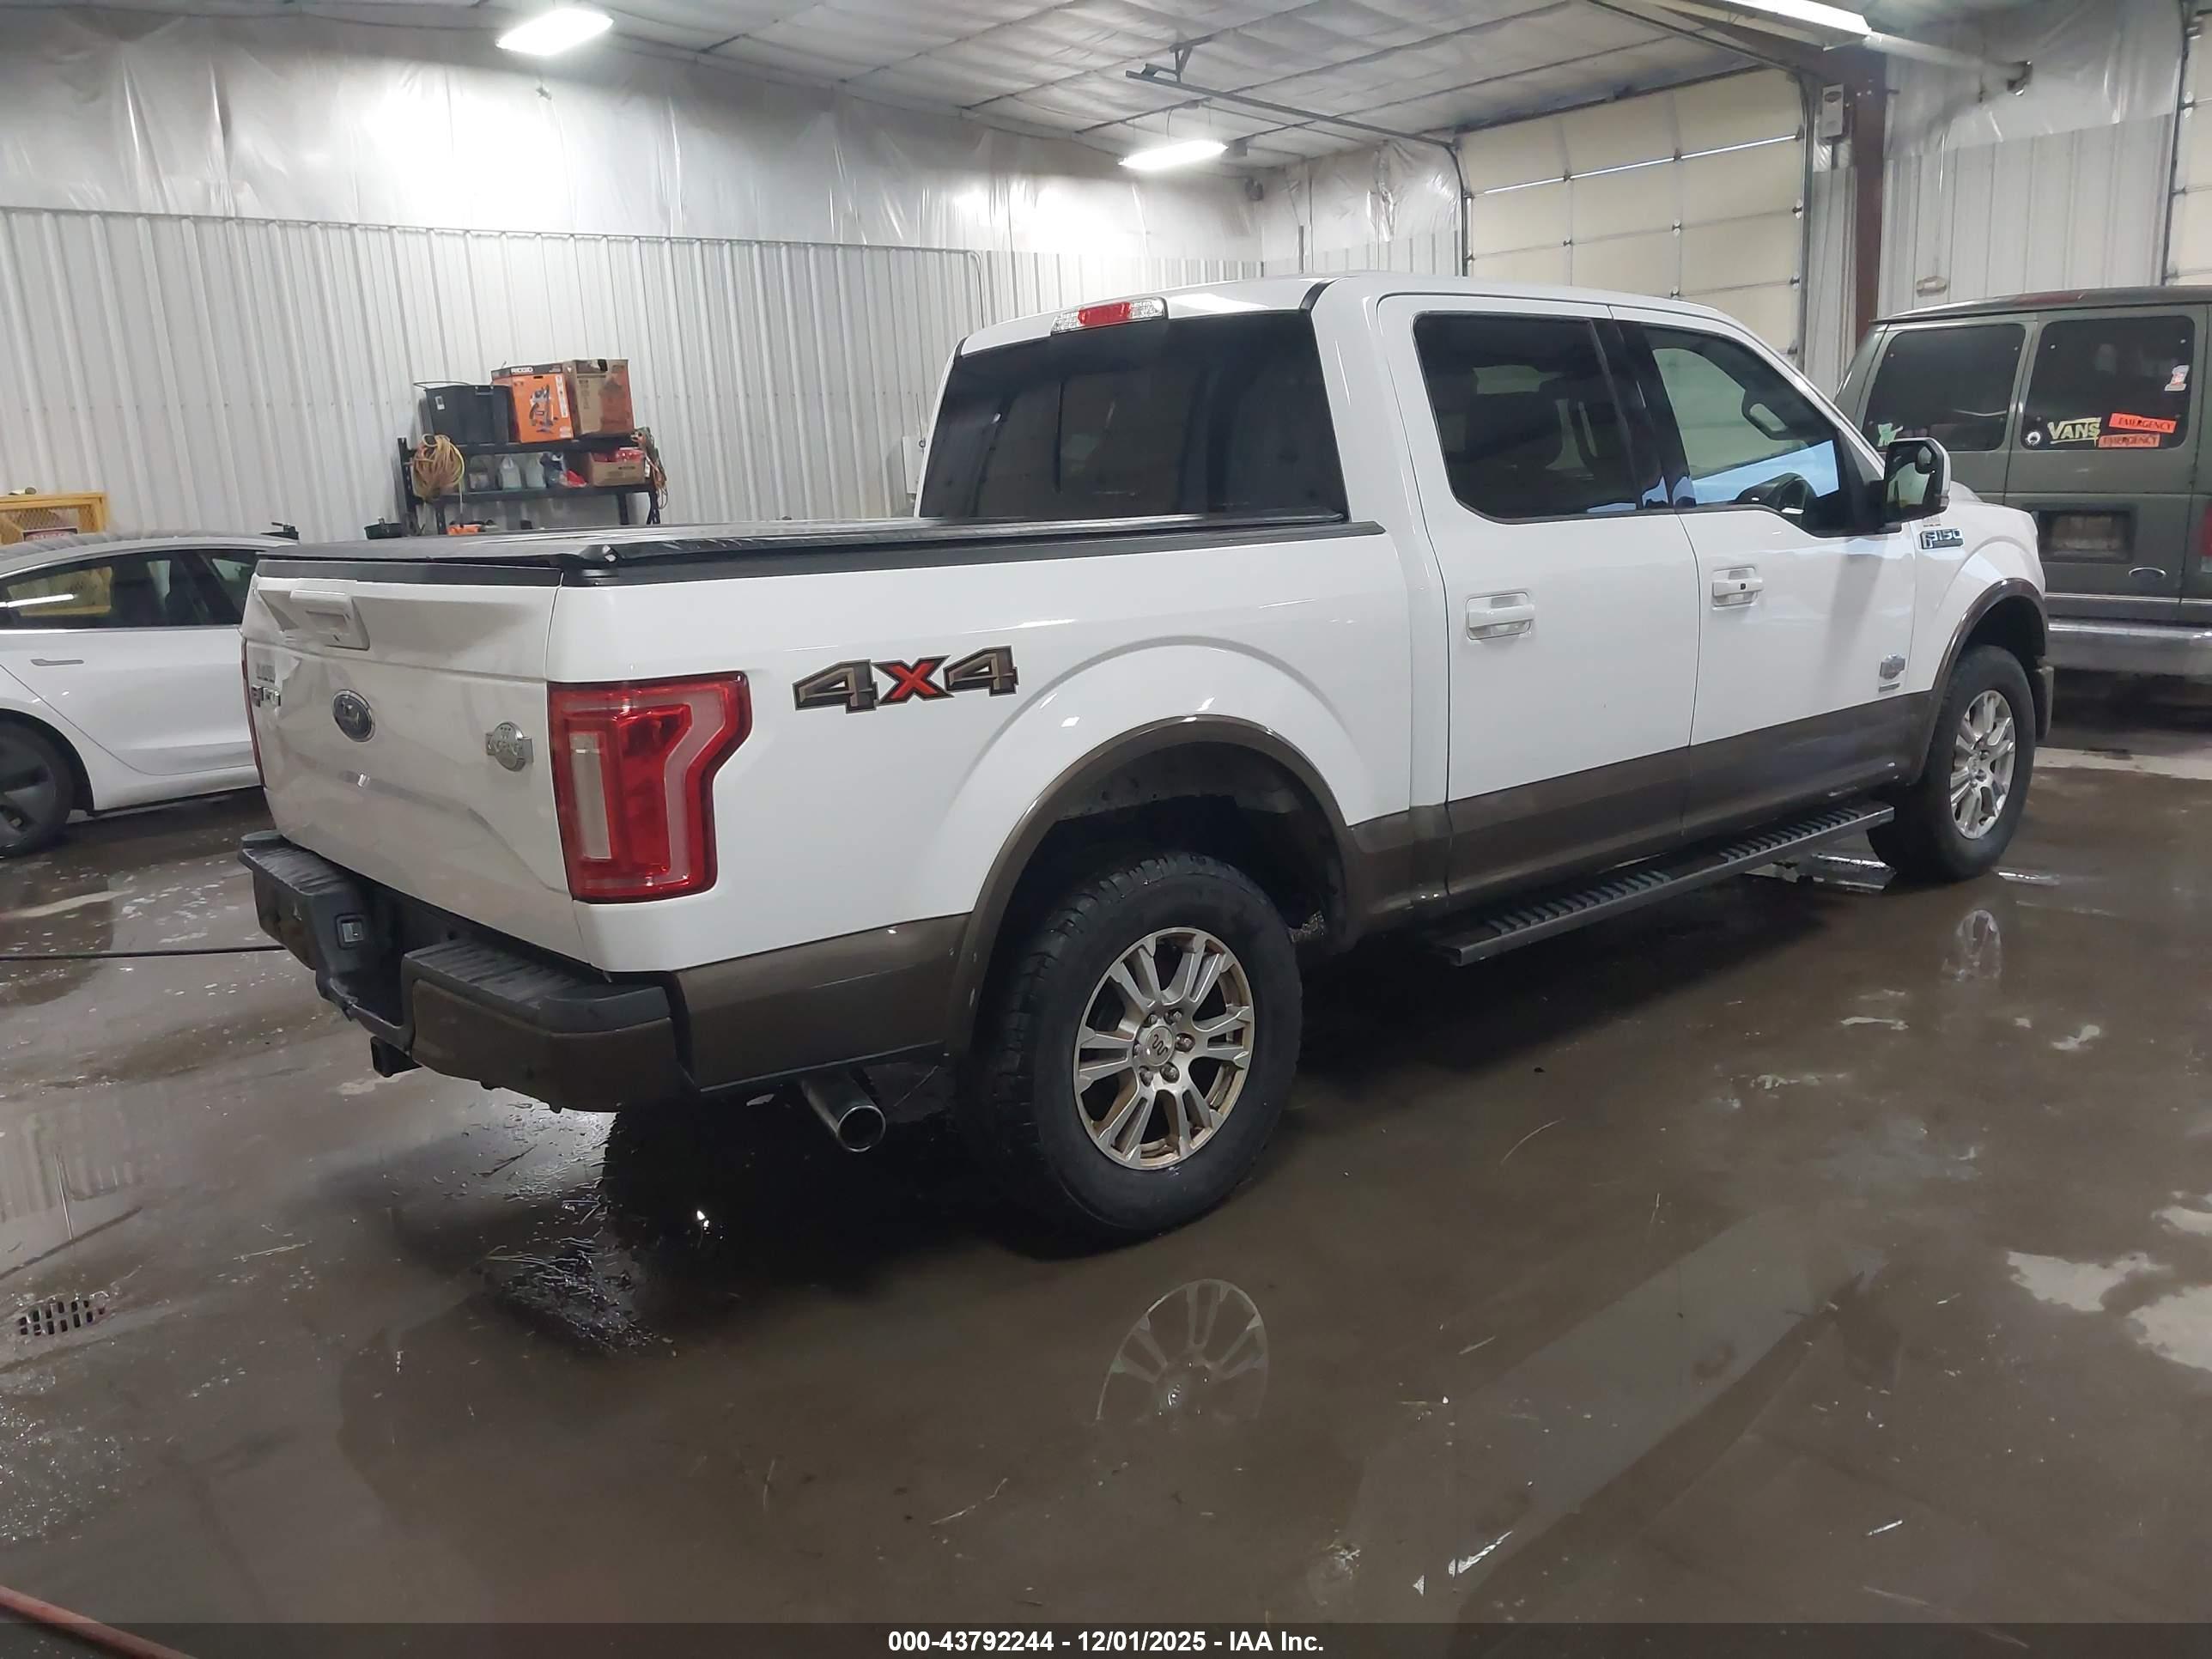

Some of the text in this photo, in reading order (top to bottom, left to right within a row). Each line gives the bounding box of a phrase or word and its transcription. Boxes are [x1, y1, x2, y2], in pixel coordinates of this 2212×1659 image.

[2047, 417, 2102, 445] VANS
[2118, 417, 2172, 431] EMERGENCY
[2103, 434, 2157, 446] EMERGENCY
